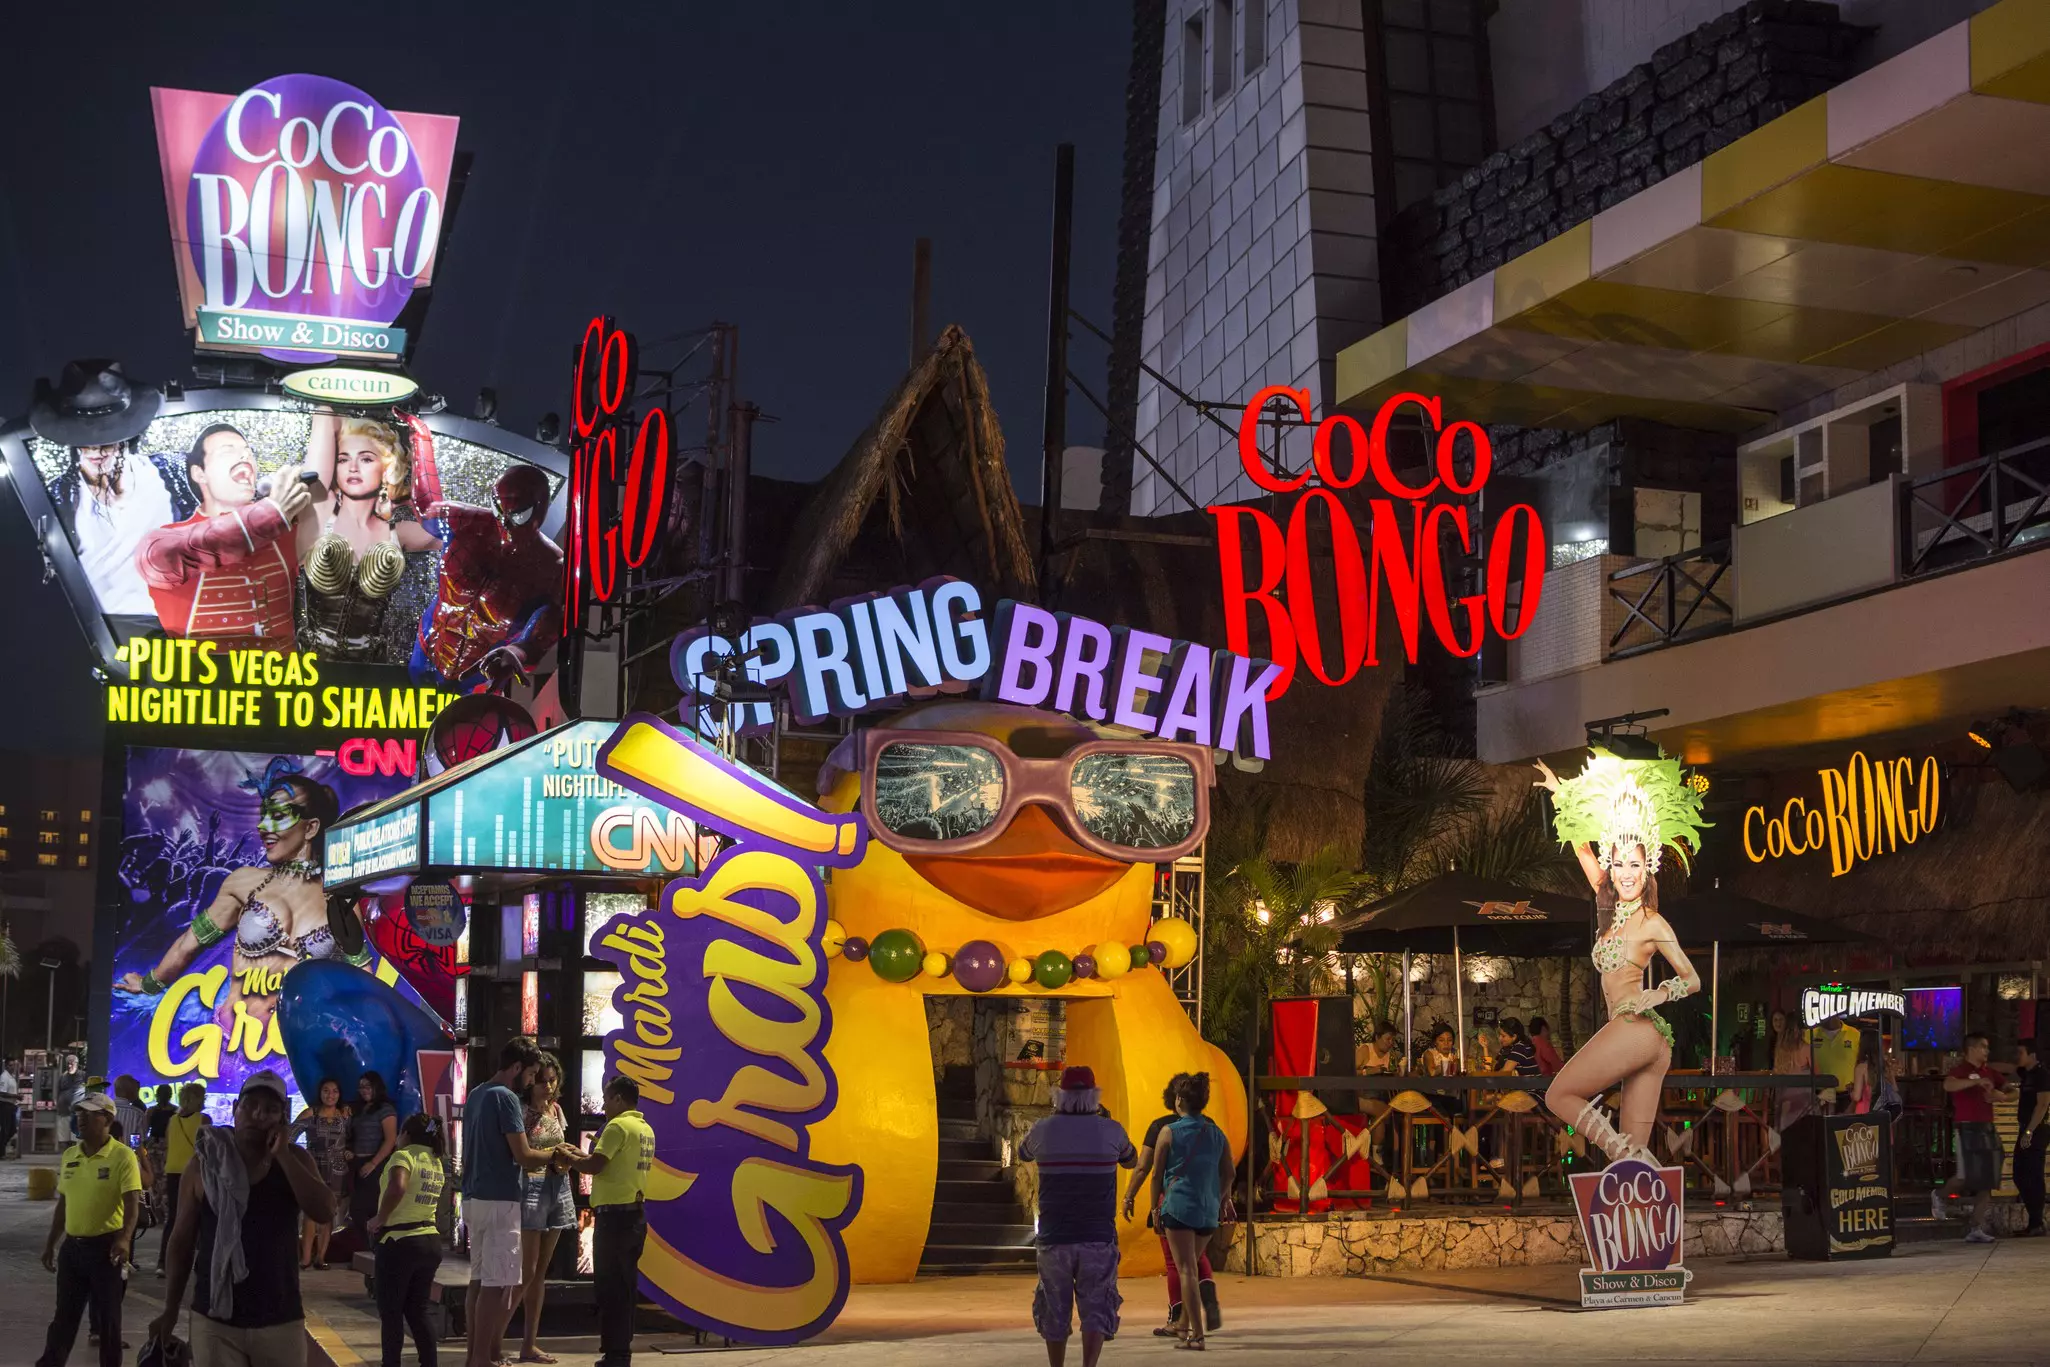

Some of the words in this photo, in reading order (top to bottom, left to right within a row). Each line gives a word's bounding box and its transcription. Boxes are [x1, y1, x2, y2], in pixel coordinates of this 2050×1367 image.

[192, 160, 441, 312] BONGO
[217, 315, 284, 342] Show
[291, 321, 314, 345] &
[321, 323, 390, 350] Disco
[307, 374, 391, 394] cancun
[1206, 488, 1546, 703] BONGO
[229, 649, 319, 687] VEGAS
[684, 580, 992, 740] SPRING
[998, 602, 1286, 761] BREAK
[107, 685, 262, 727] NIGHTLIFE
[274, 691, 315, 728] TO
[1817, 750, 1940, 878] BONGO
[590, 805, 719, 872] CNN
[410, 884, 451, 895] ACEPTAMOS
[423, 894, 453, 907] ACCEPT
[425, 926, 454, 940] VISA
[601, 918, 681, 1105] Mardi
[1804, 990, 1848, 1027] GOLD
[1848, 990, 1905, 1018] MEMBER
[1830, 1188, 1856, 1209] GOLD
[1855, 1186, 1888, 1201] MEMBER
[1590, 1202, 1681, 1272] BONGO
[1838, 1207, 1889, 1233] HERE
[1583, 1296, 1605, 1306] Playa
[1613, 1295, 1644, 1304] Carmen
[1652, 1293, 1682, 1302] Cancun
[1593, 1276, 1627, 1290] Show
[1629, 1275, 1640, 1288] &
[1644, 1274, 1677, 1287] Disco
